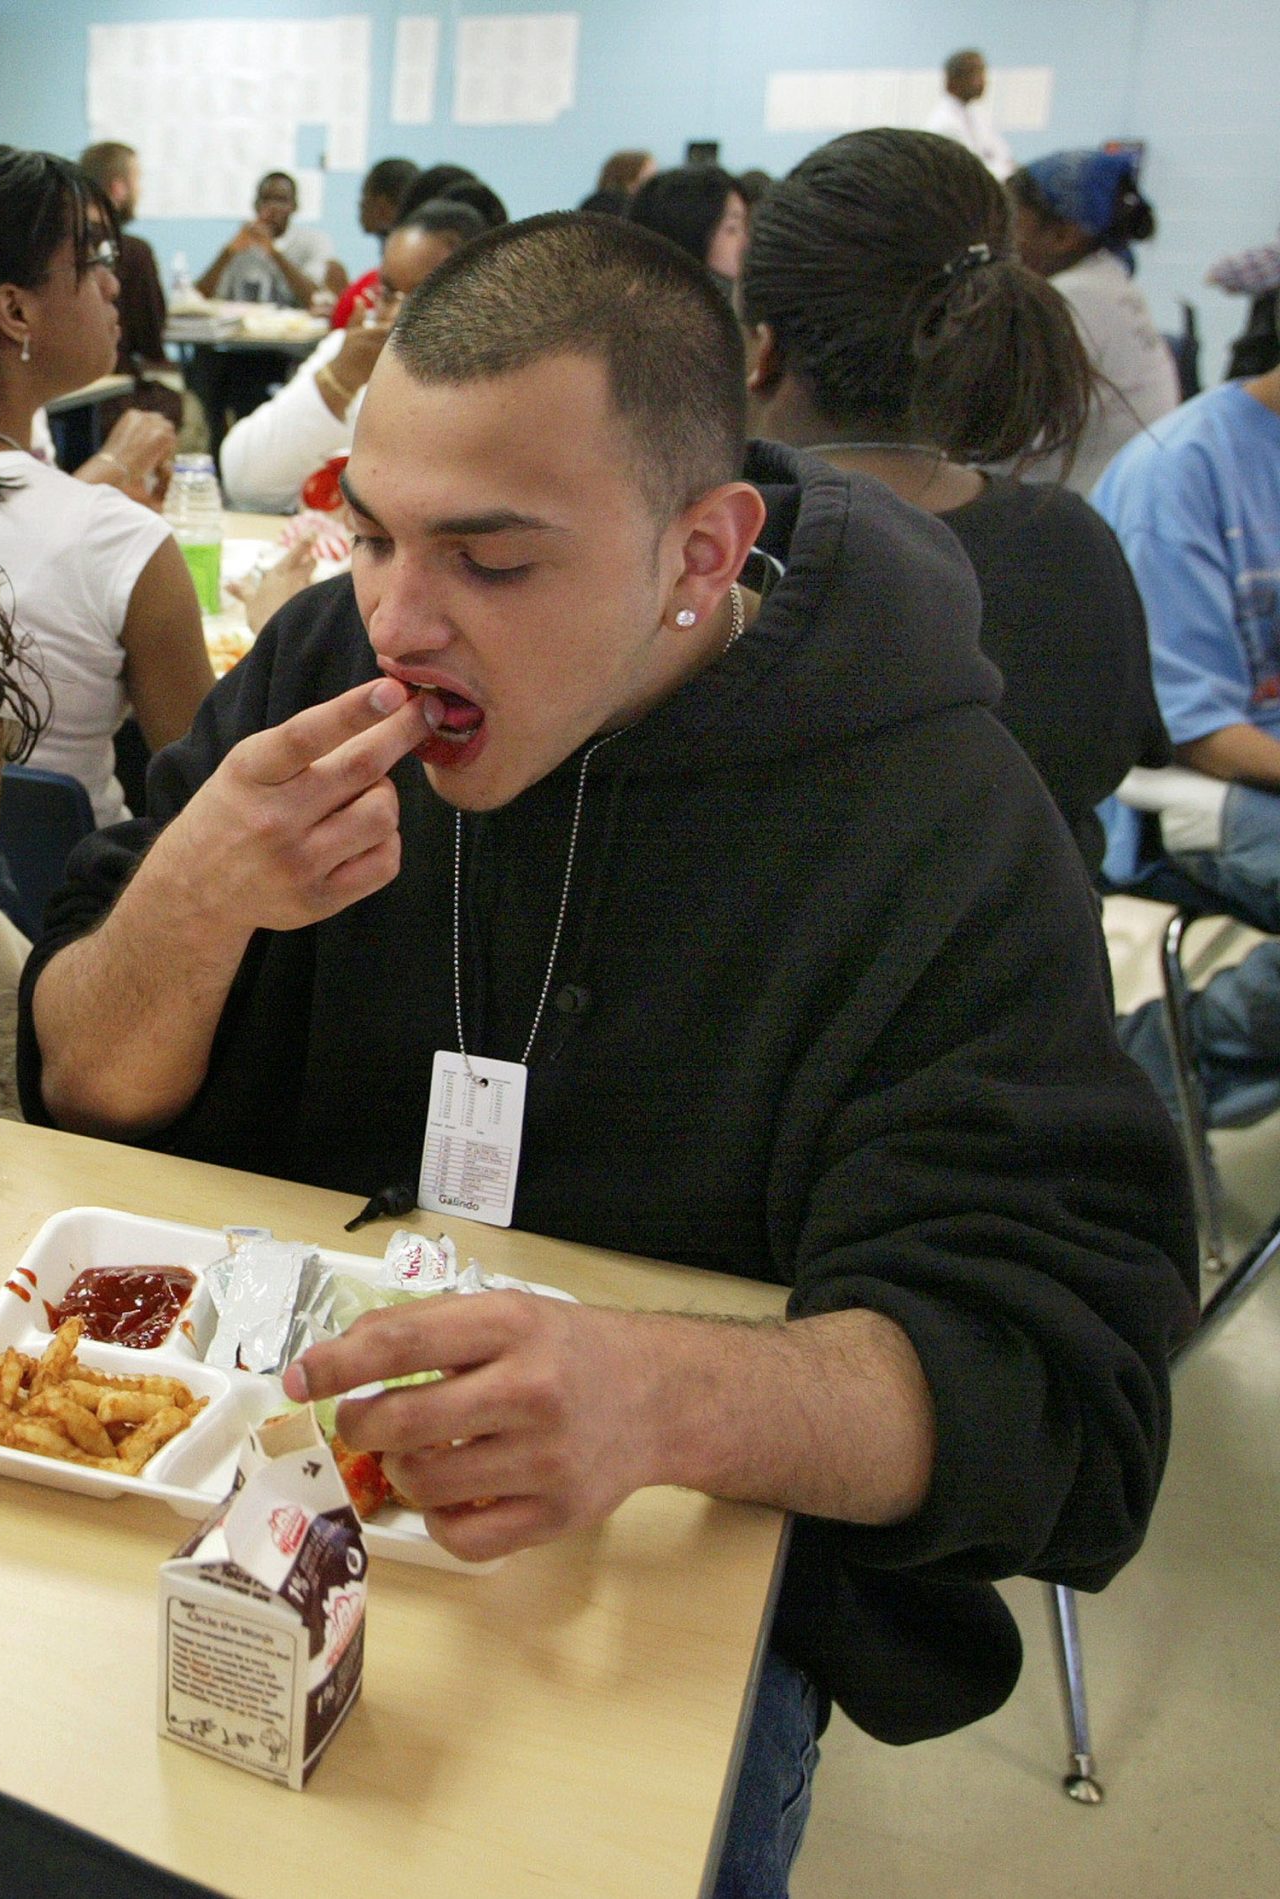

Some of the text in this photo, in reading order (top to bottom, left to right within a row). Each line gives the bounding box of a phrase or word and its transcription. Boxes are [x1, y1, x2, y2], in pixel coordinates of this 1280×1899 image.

[438, 1194, 480, 1212] Galindo
[187, 1610, 218, 1627] Circle
[221, 1620, 238, 1633] the
